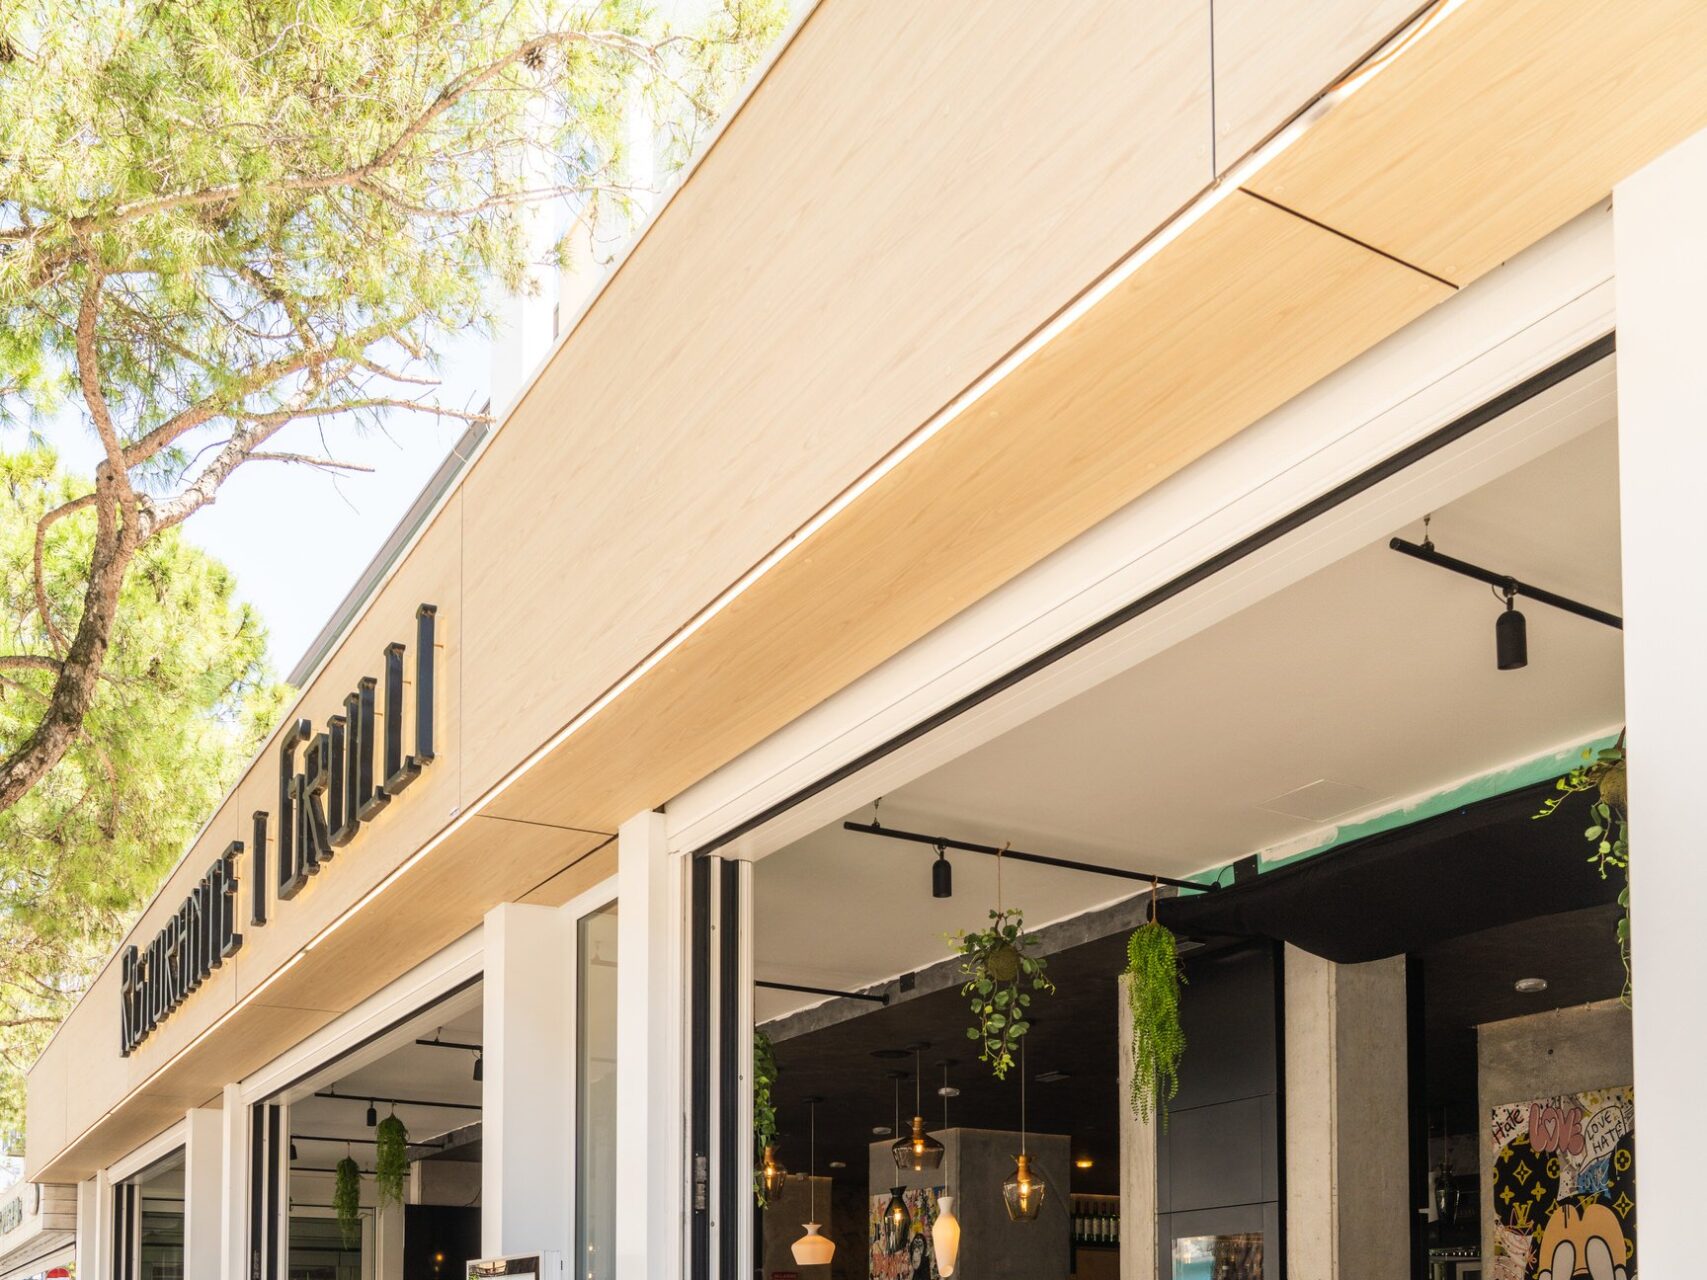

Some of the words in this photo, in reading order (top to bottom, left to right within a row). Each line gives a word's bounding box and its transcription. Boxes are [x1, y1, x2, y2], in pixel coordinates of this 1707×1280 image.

[278, 602, 438, 901] GRULLI
[1492, 1107, 1525, 1145] Hate
[1529, 1102, 1585, 1156] LOVE
[1586, 1110, 1612, 1141] LOVE
[1591, 1119, 1622, 1155] HATE
